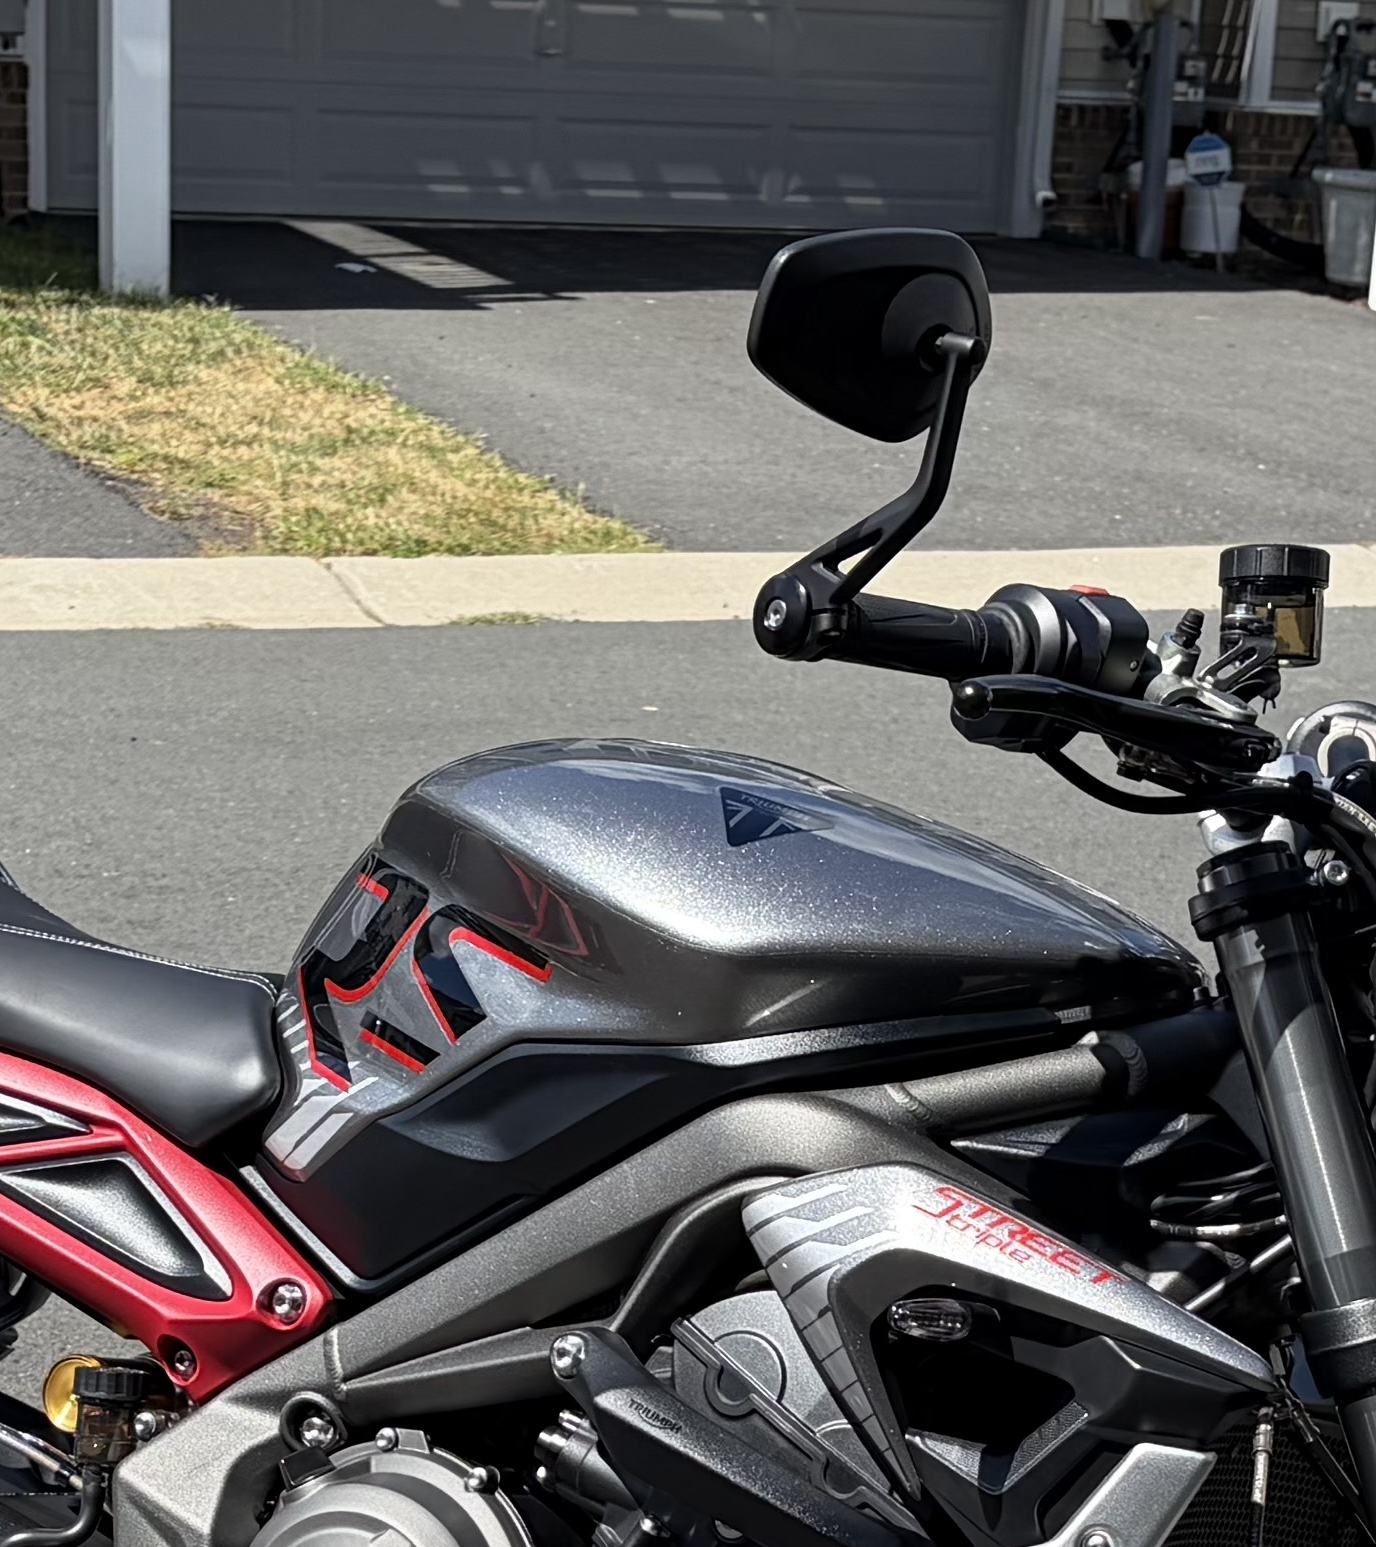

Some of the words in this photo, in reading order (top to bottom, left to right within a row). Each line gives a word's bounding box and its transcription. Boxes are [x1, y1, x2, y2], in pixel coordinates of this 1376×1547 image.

[912, 1185, 1131, 1284] STREET
[945, 1214, 1032, 1267] triple
[628, 1397, 683, 1434] TRIUMPH
